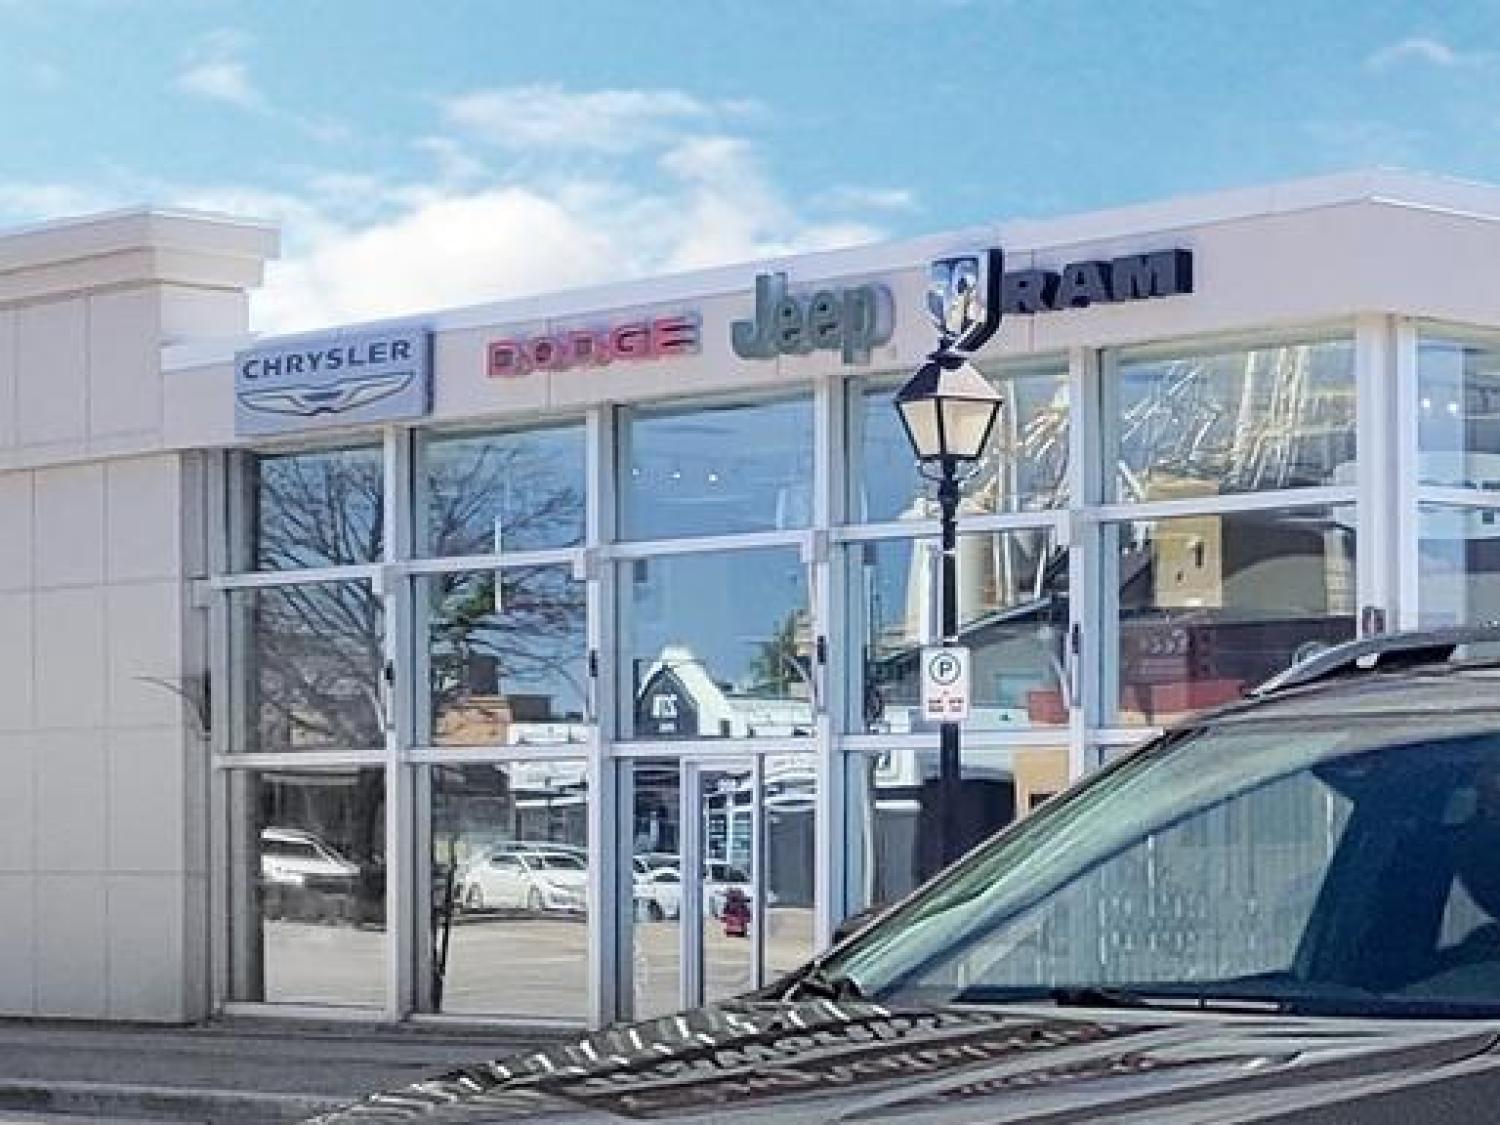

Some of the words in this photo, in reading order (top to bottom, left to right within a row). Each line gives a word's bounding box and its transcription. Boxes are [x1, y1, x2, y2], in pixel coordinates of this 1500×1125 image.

[1002, 248, 1194, 315] RAM
[486, 315, 702, 378] DODGE
[730, 271, 895, 364] Jeep
[241, 338, 412, 380] CHRYSLER
